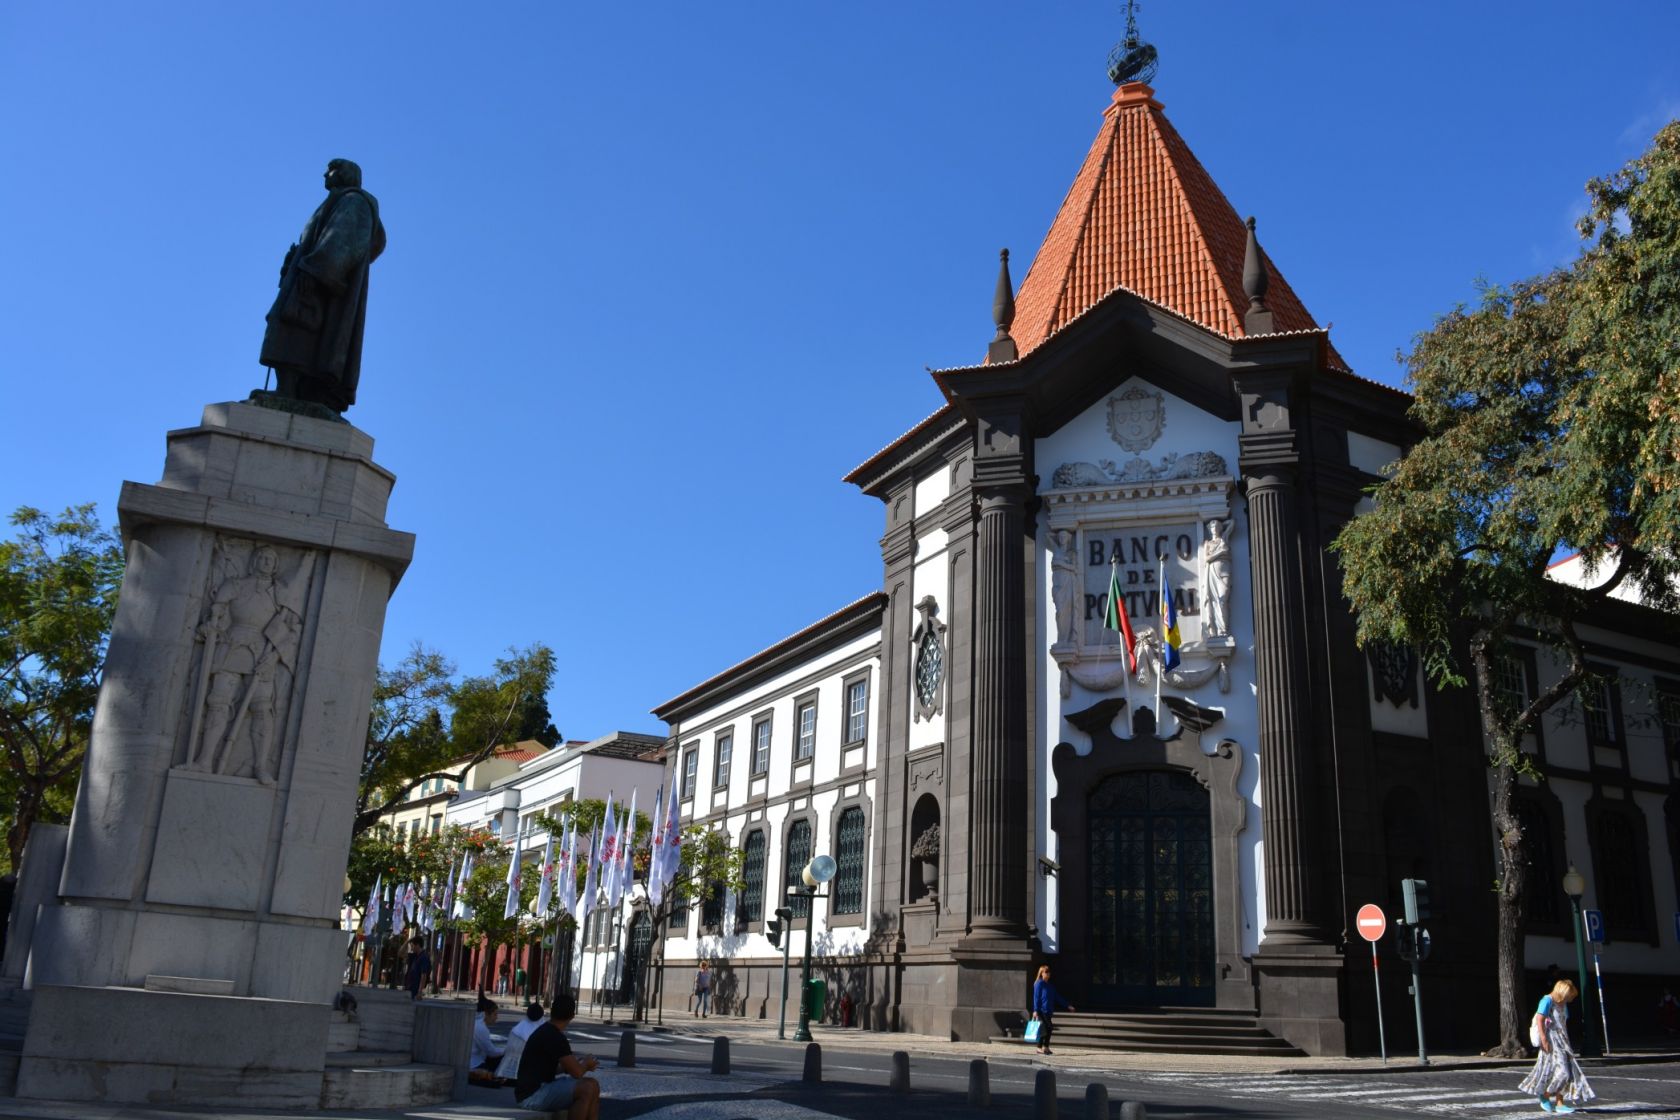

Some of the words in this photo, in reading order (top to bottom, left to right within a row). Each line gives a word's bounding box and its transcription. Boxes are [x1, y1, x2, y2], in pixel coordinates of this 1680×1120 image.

[1089, 534, 1192, 566] BANCO
[1127, 569, 1155, 584] DE
[1590, 914, 1600, 939] P
